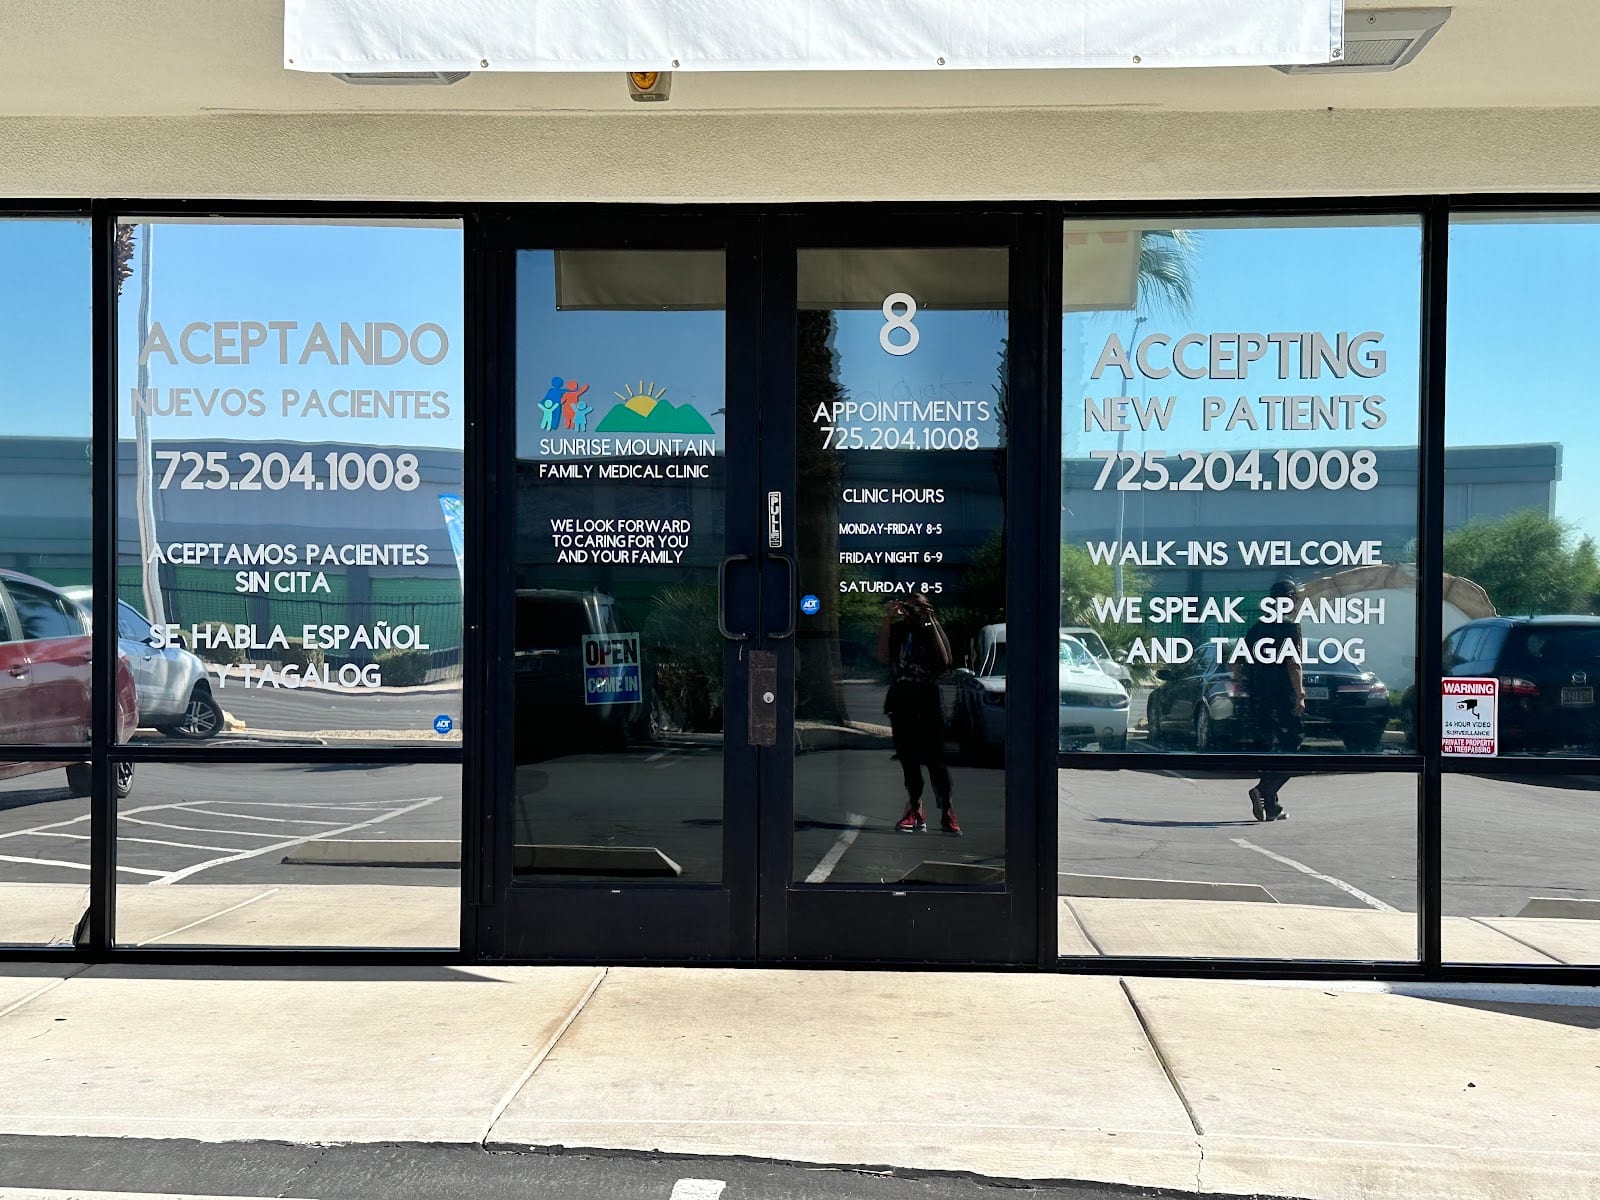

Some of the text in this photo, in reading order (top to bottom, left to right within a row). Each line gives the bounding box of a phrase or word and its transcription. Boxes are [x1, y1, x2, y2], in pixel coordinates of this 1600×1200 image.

[880, 293, 919, 356] 8
[139, 321, 449, 365] ACEPTANDO
[1090, 331, 1387, 379] ACCEPTING
[131, 388, 450, 419] NUEVOS PACIENTES
[813, 401, 990, 422] APPOINTMENTS
[1084, 395, 1387, 432] NEW PATIENTS
[540, 438, 716, 456] SUNRISE MOUNTAIN
[820, 427, 979, 450] 725.204.1008
[155, 452, 420, 491] 725.204.1008
[539, 464, 709, 479] FAMILY MEDICAL CLINIC
[1090, 450, 1379, 491] 725.204.1008
[843, 488, 945, 503] CLINIC HOURS
[770, 496, 779, 533] PULL
[550, 519, 691, 533] WE LOOK FORWARD
[839, 523, 943, 535] MONDAY-FRIDAY 8-5
[552, 535, 689, 548] TO CARING FOR YOU
[147, 543, 430, 566] ACEPTAMOS PACIENTES
[557, 550, 683, 564] AND YOUR FAMILY
[840, 552, 943, 564] FRIDAY NIGHT 6-9
[1087, 540, 1382, 566] WALK-INS WELCOME
[235, 571, 331, 593] SIN CITA
[840, 581, 943, 593] SATURDAY 8-5
[803, 600, 817, 608] ADT
[1092, 597, 1385, 625] WE SPEAK SPANISH
[149, 621, 430, 650] SE HABLA ESPAÑOL
[586, 639, 638, 666] OPEN
[1126, 637, 1365, 664] AND TAGALOG
[214, 663, 382, 688] Y TAGALOG
[588, 676, 638, 693] COME IN
[1443, 683, 1494, 694] WARNING
[436, 720, 450, 728] ADT
[1466, 739, 1494, 747] PROPERTY
